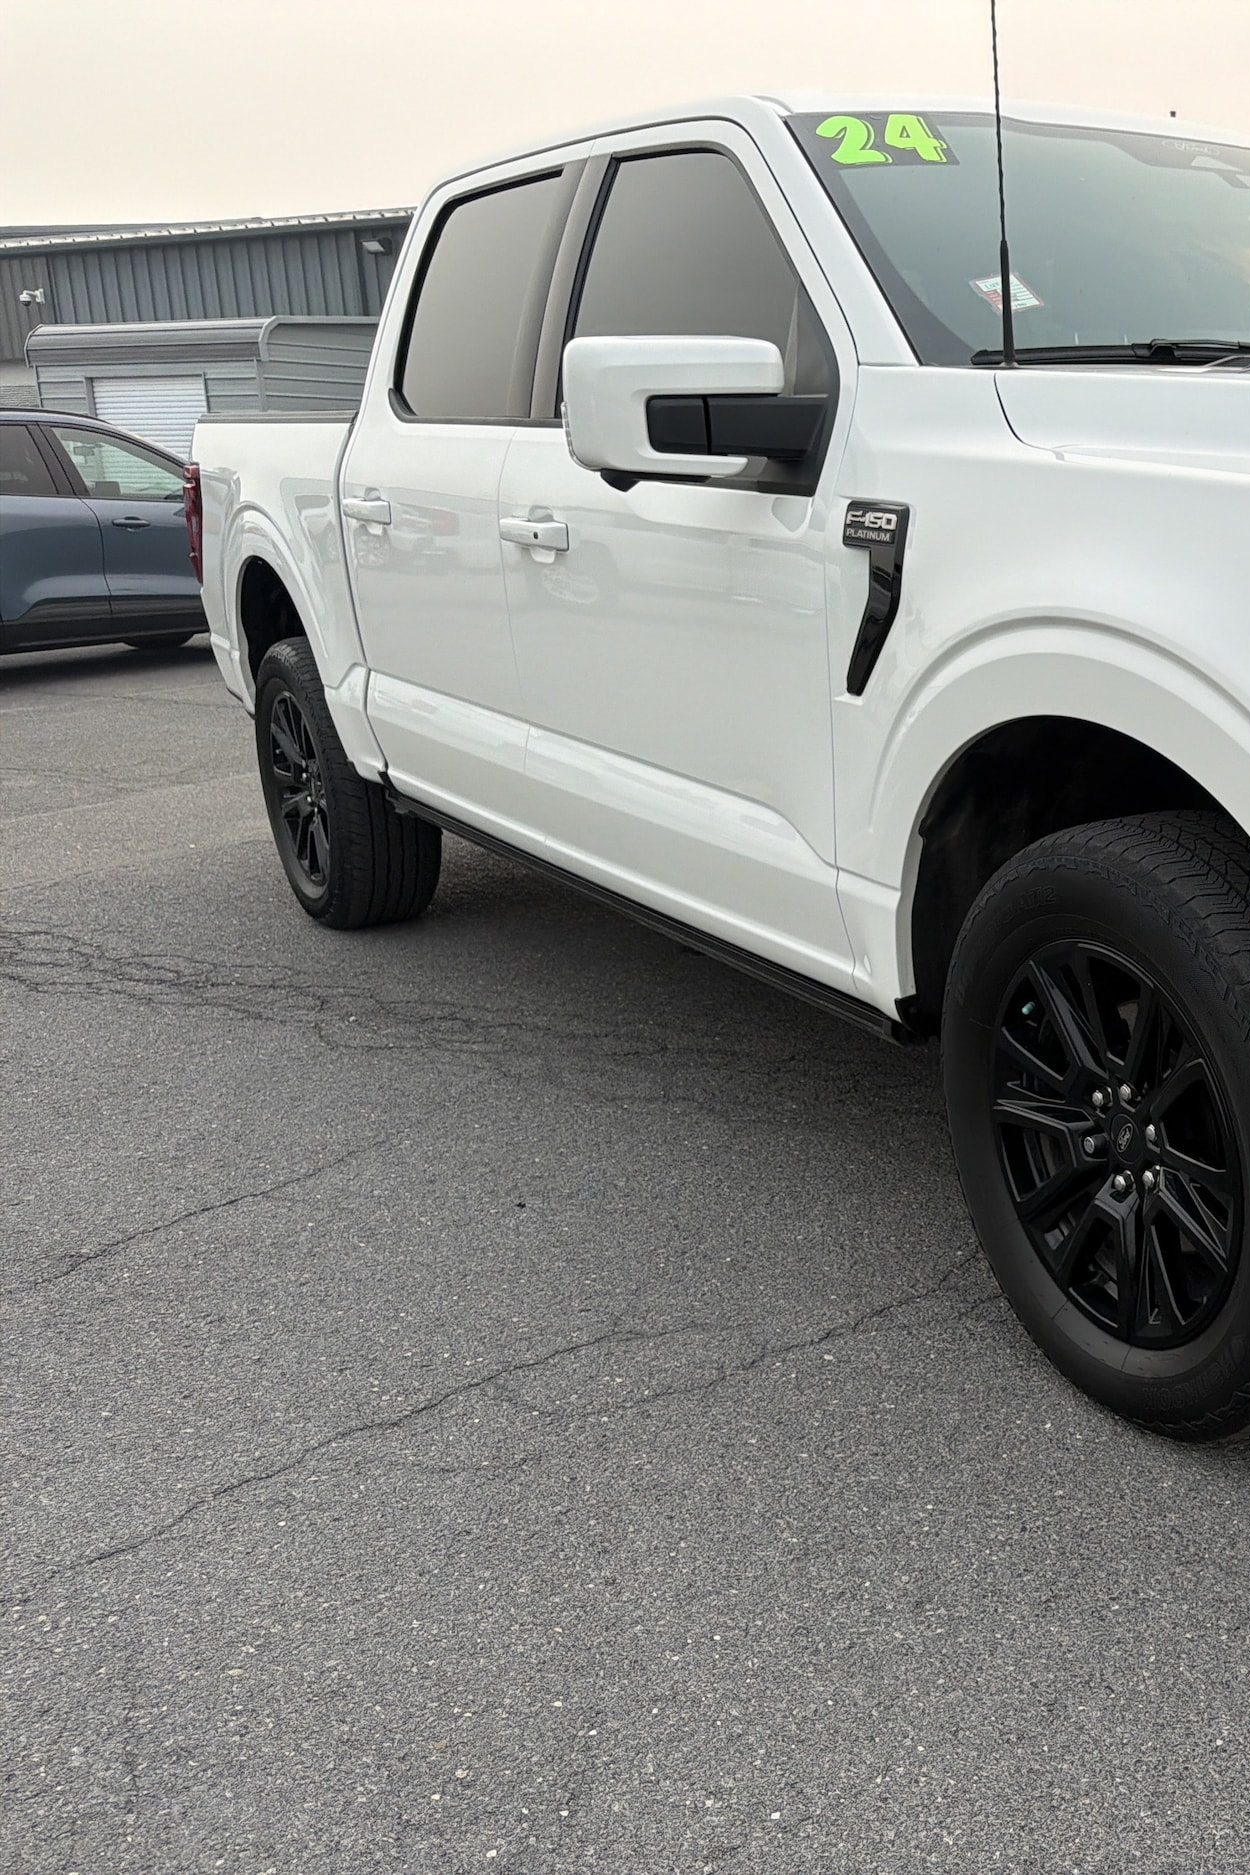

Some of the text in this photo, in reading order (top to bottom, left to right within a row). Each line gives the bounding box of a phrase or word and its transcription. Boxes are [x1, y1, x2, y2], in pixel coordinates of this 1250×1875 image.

[816, 113, 948, 165] 24
[846, 510, 898, 530] F-150
[846, 528, 890, 542] PLATINUM
